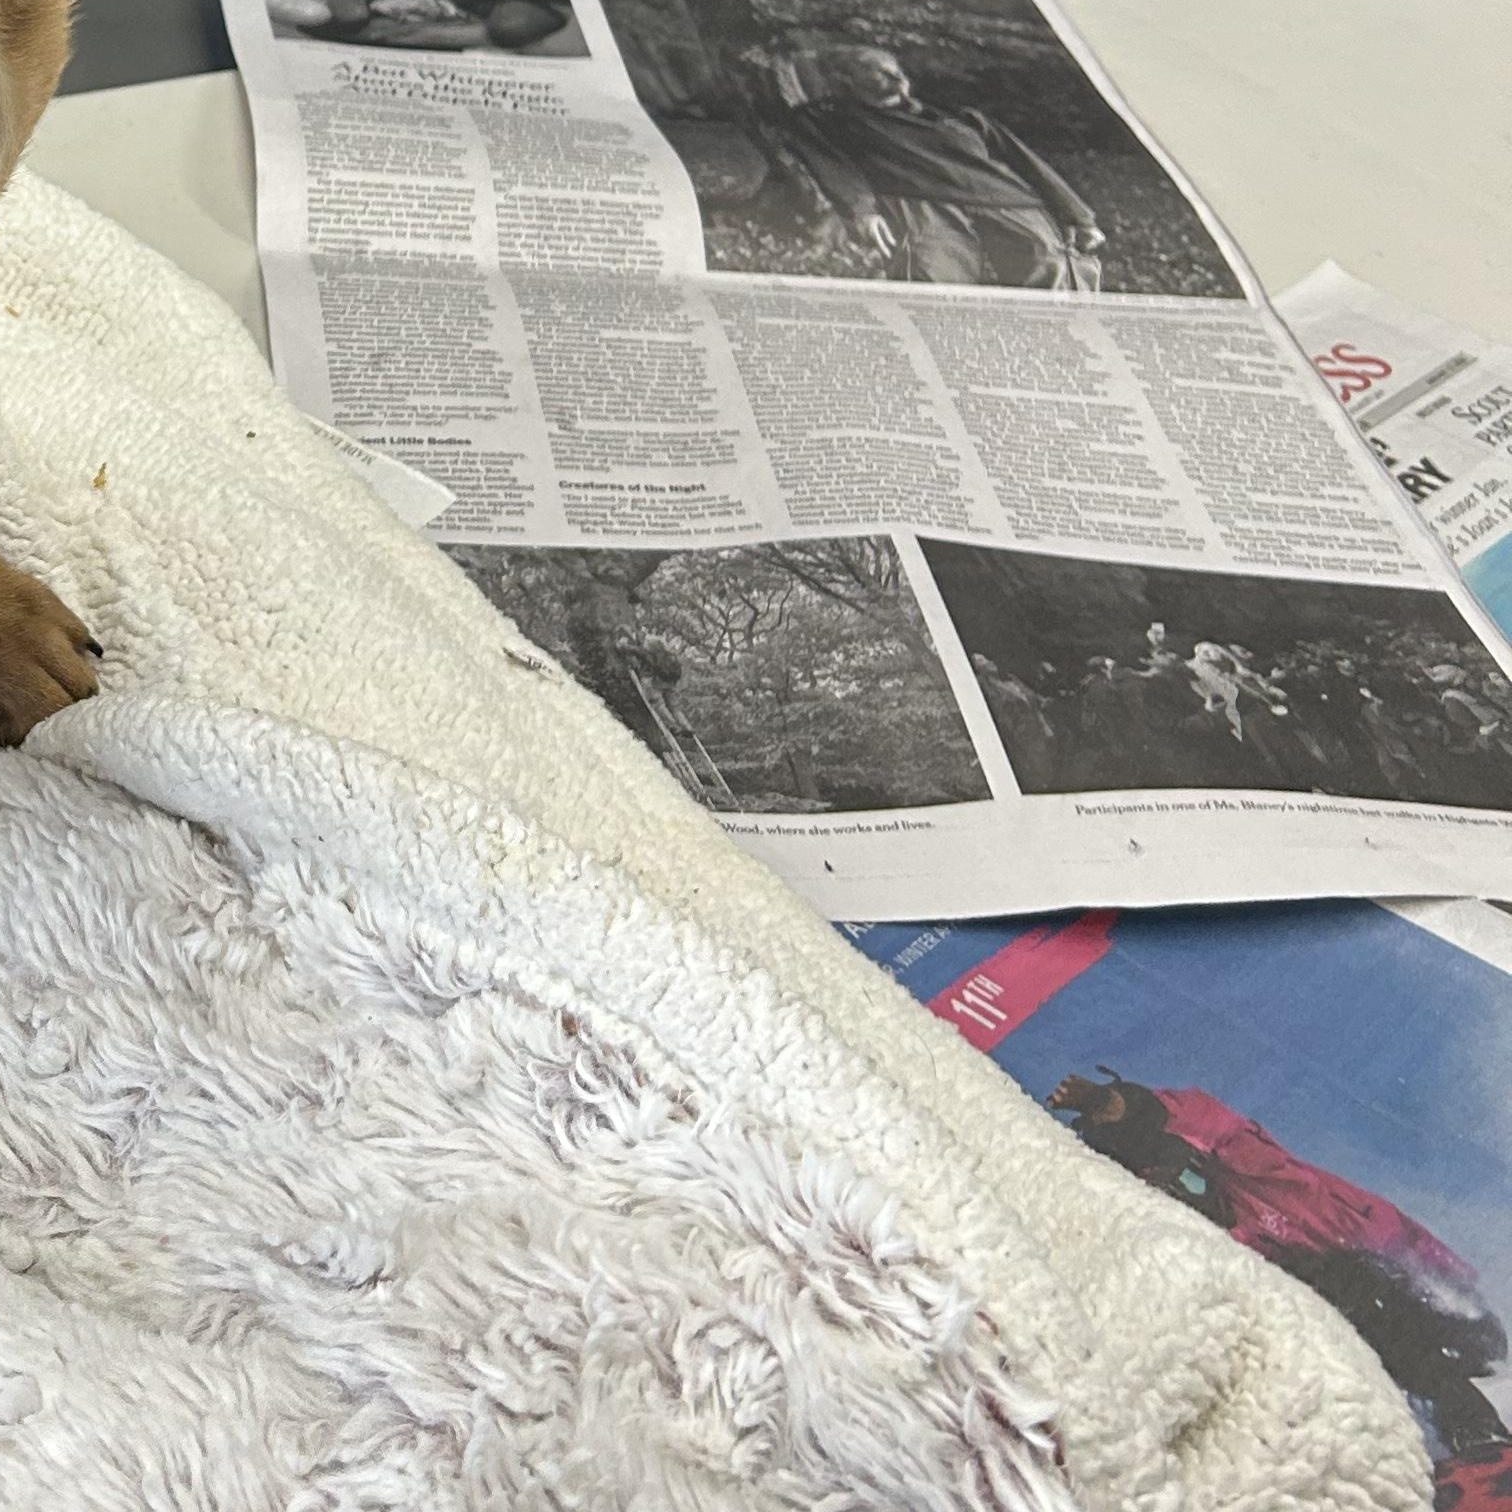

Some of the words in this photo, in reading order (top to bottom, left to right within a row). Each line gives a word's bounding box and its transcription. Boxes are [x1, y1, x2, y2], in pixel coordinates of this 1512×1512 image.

[390, 436, 423, 445] Little
[427, 437, 471, 445] Bodies
[558, 480, 624, 490] Creatures
[627, 483, 639, 491] of
[644, 484, 666, 492] the
[669, 483, 705, 493] Night
[1074, 802, 1154, 817] Participants
[1155, 801, 1170, 813] in
[1171, 801, 1197, 813] one
[1198, 799, 1212, 811] of
[720, 821, 765, 836] Wood,
[766, 824, 807, 837] where
[808, 824, 831, 837] she
[832, 822, 873, 836] works
[875, 820, 900, 833] and
[901, 819, 937, 832] lives.
[892, 932, 941, 969] WINTER
